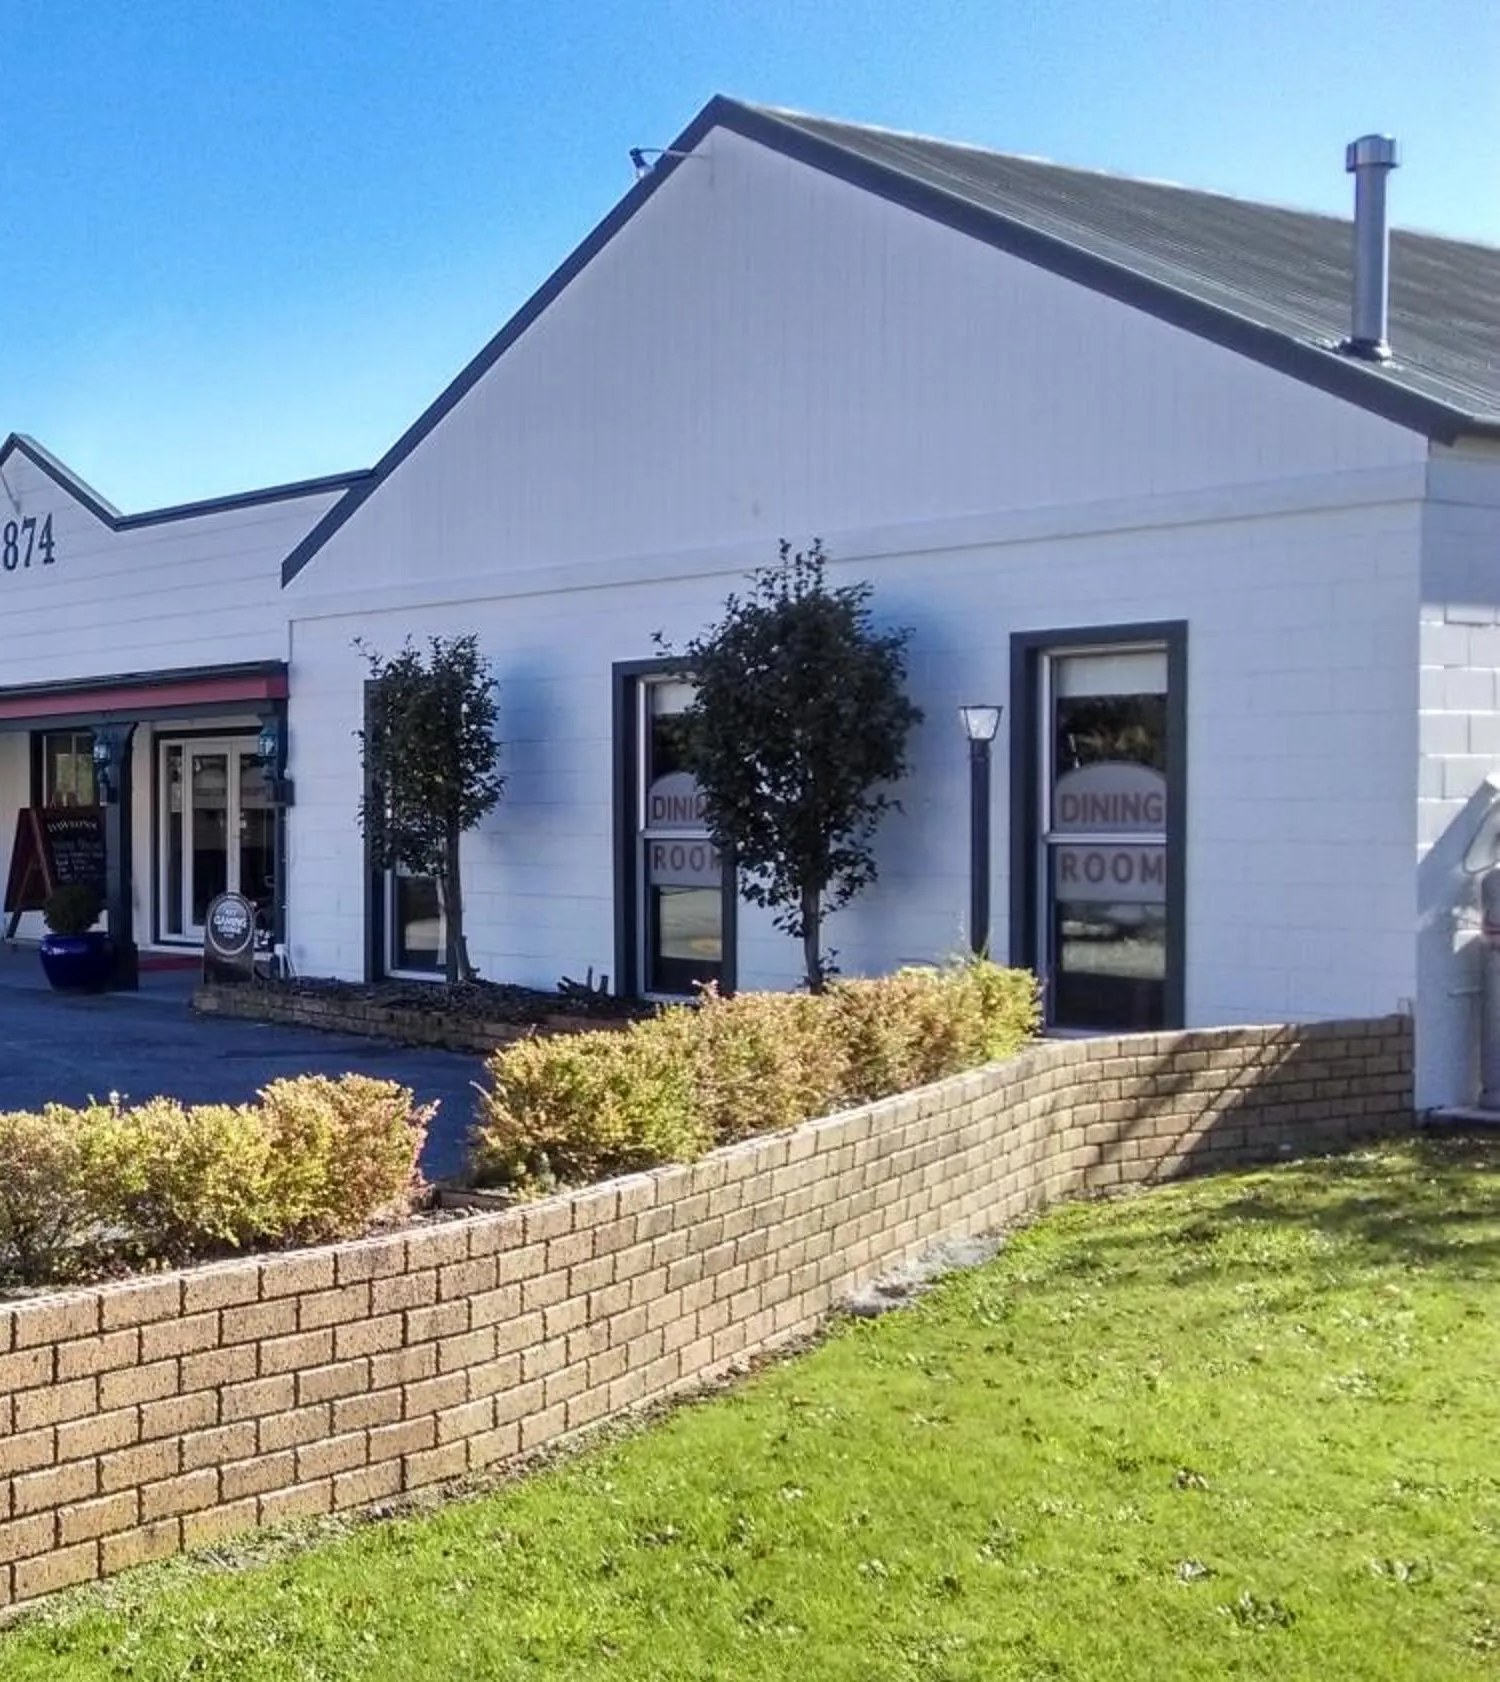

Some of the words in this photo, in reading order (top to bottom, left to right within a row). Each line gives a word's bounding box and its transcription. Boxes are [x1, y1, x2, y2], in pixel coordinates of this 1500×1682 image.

[652, 794, 706, 821] DINI
[1060, 792, 1163, 823] DINING
[1060, 852, 1164, 884] ROOM
